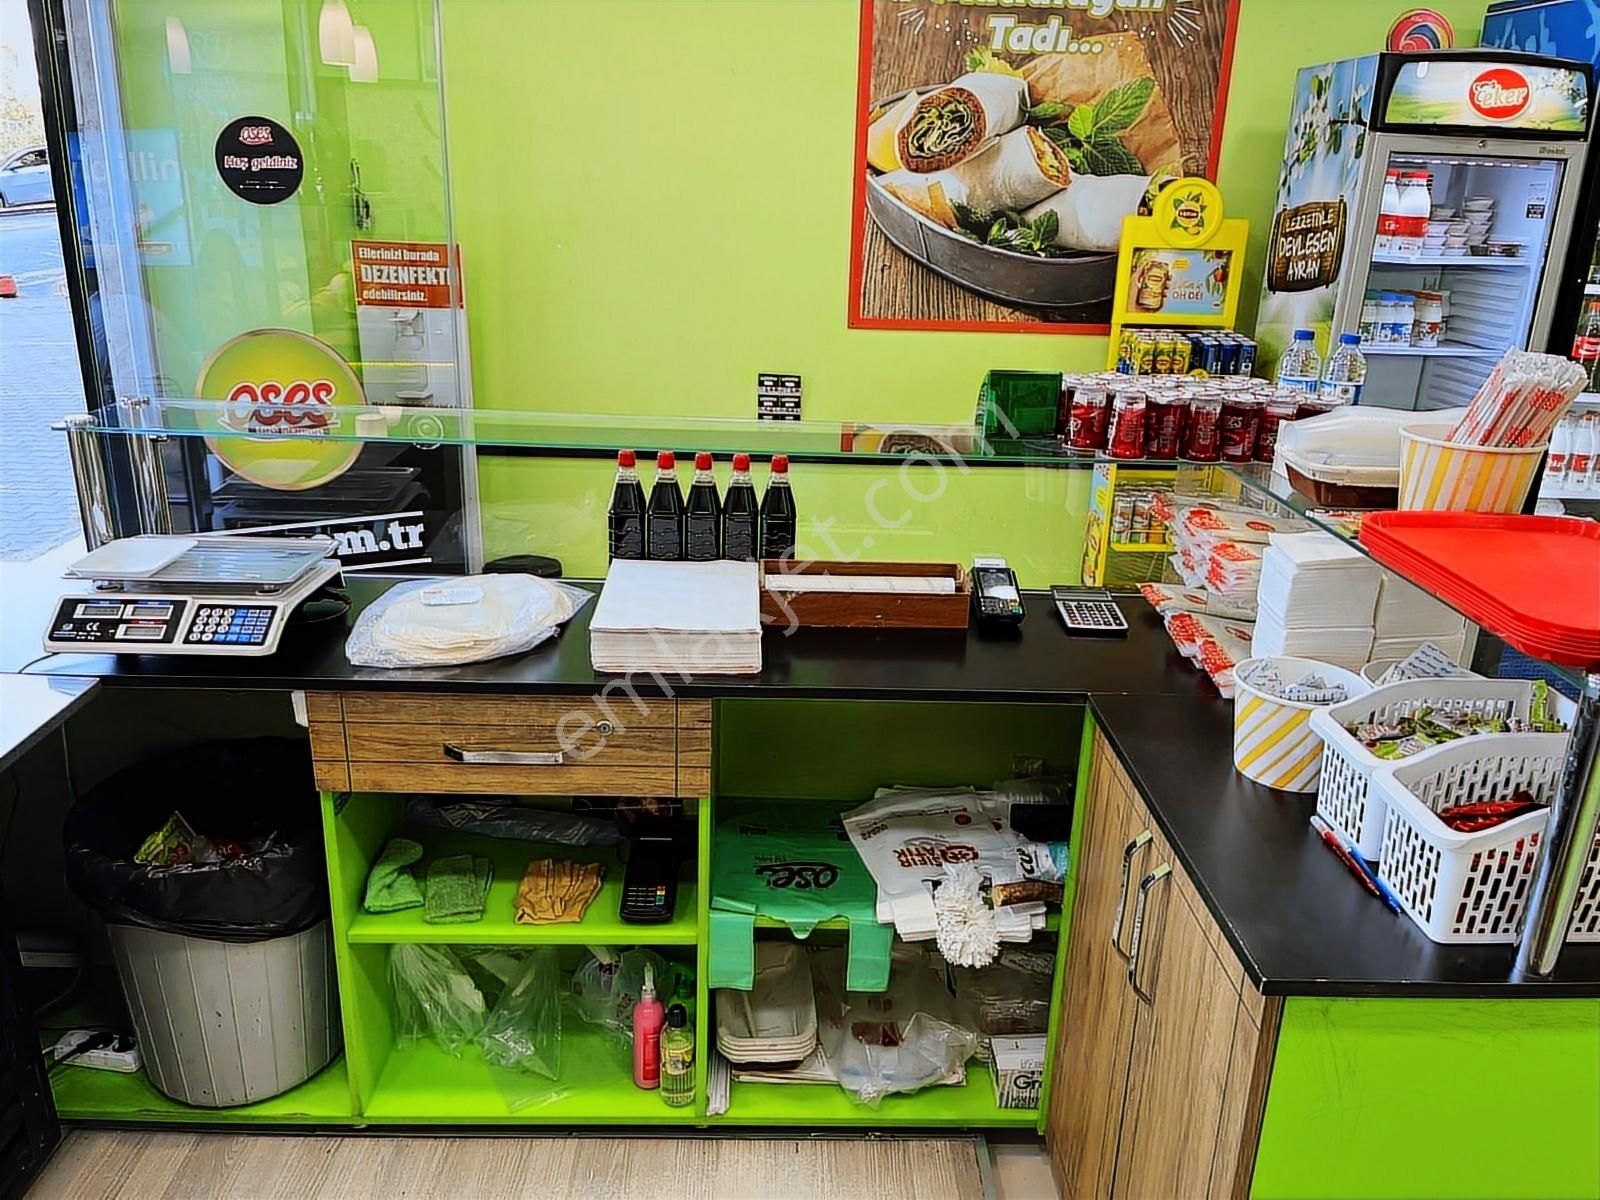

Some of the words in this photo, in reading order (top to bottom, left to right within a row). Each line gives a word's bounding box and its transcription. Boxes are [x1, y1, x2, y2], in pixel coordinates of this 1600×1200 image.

[359, 248, 401, 260] Ellerinizi
[403, 250, 440, 262] burada
[360, 264, 450, 285] DEZENFEKT
[1286, 258, 1320, 281] AYRAN
